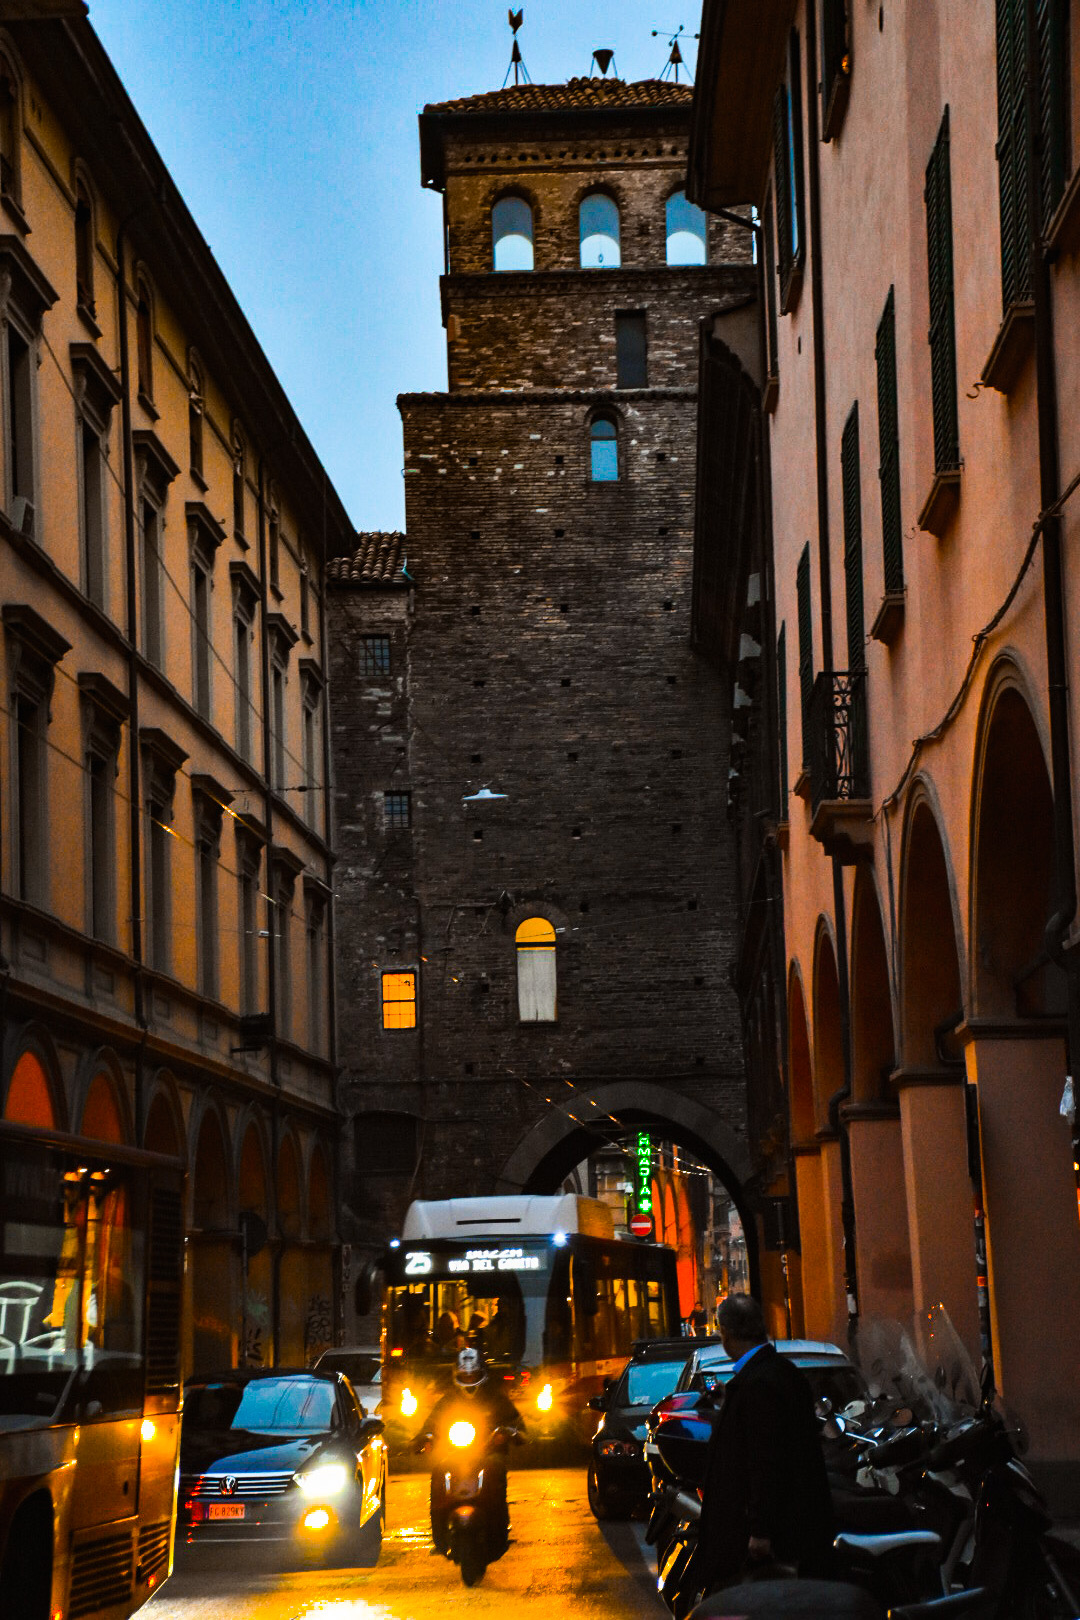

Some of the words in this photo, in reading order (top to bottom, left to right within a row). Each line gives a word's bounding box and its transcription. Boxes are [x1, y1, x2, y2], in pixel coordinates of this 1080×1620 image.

[405, 1252, 432, 1274] 25
[448, 1259, 470, 1271] VIA
[472, 1259, 495, 1271] DEL
